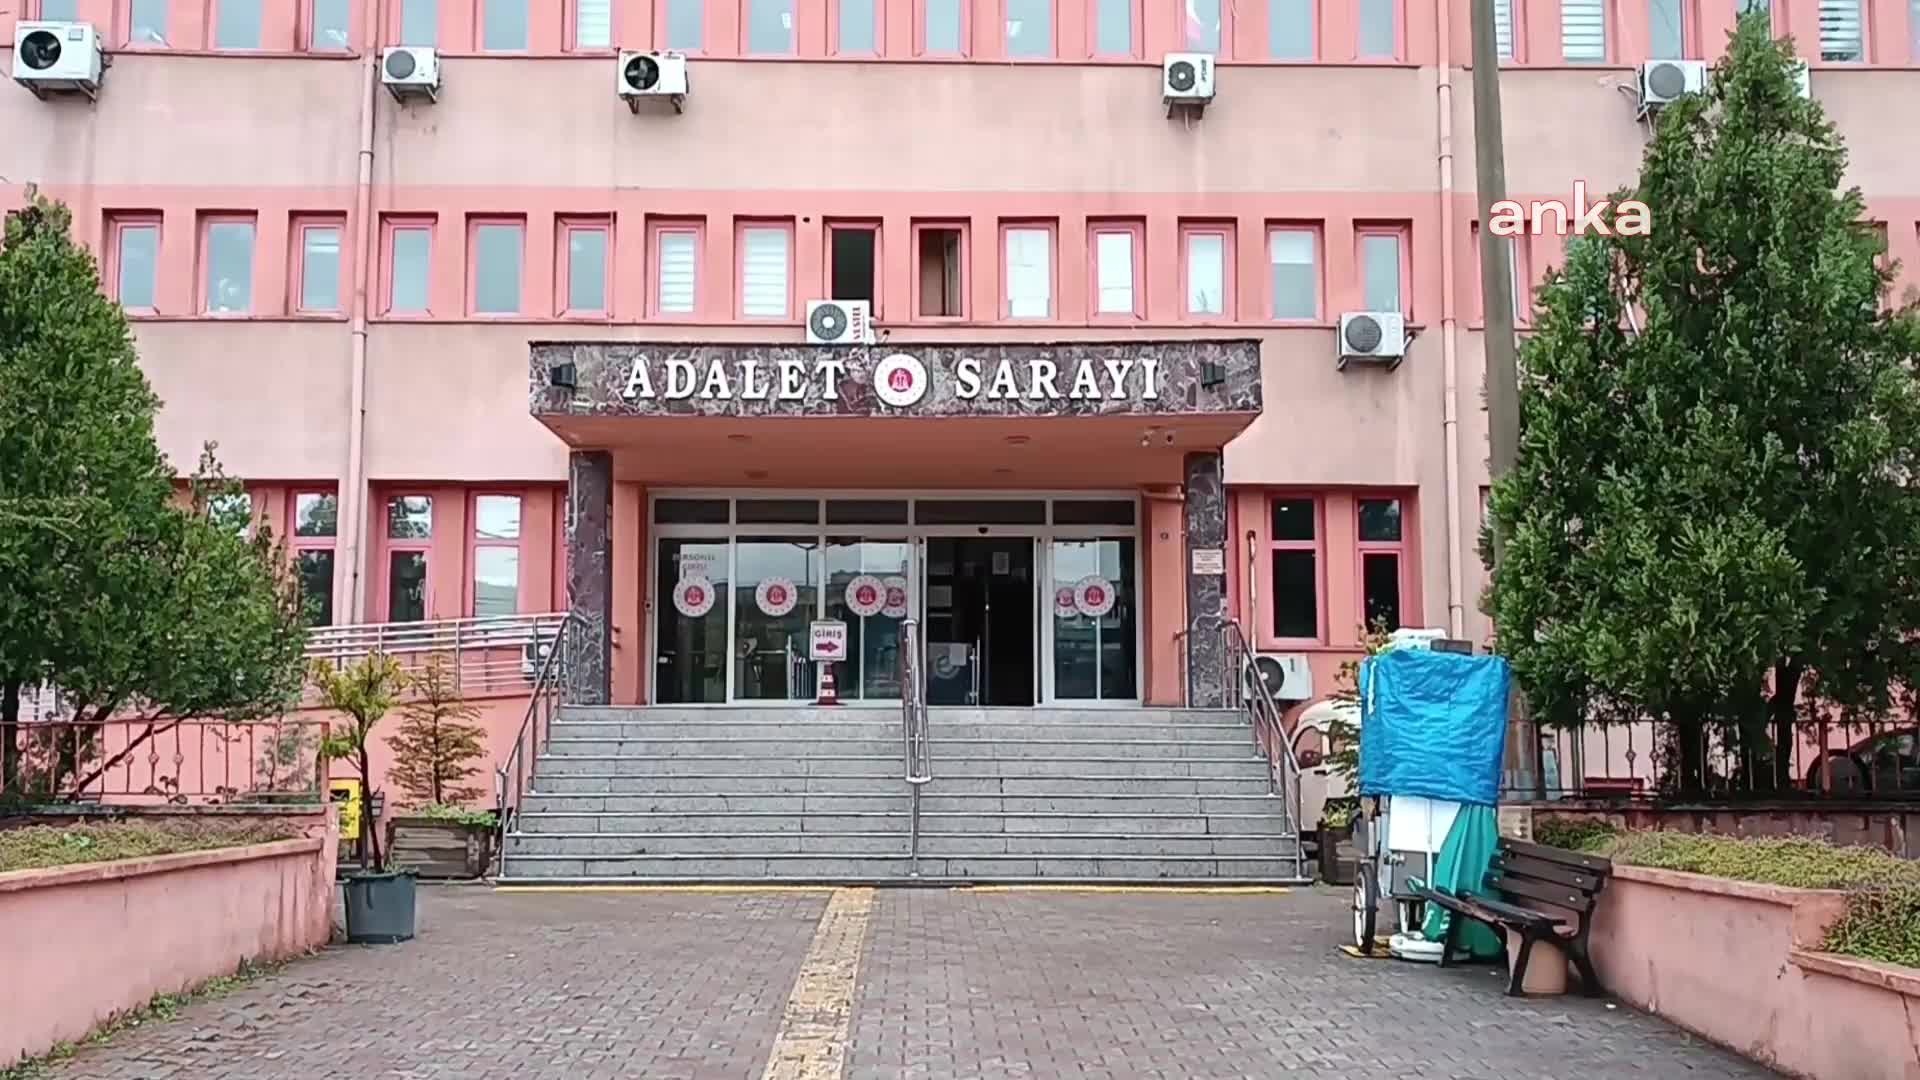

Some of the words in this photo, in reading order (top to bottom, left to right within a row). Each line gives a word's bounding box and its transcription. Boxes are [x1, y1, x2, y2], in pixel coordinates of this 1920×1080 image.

[851, 306, 862, 340] VESTEL
[622, 358, 846, 400] ADALET
[956, 358, 1158, 400] SARAYI
[815, 628, 842, 640] GİRİŞ
